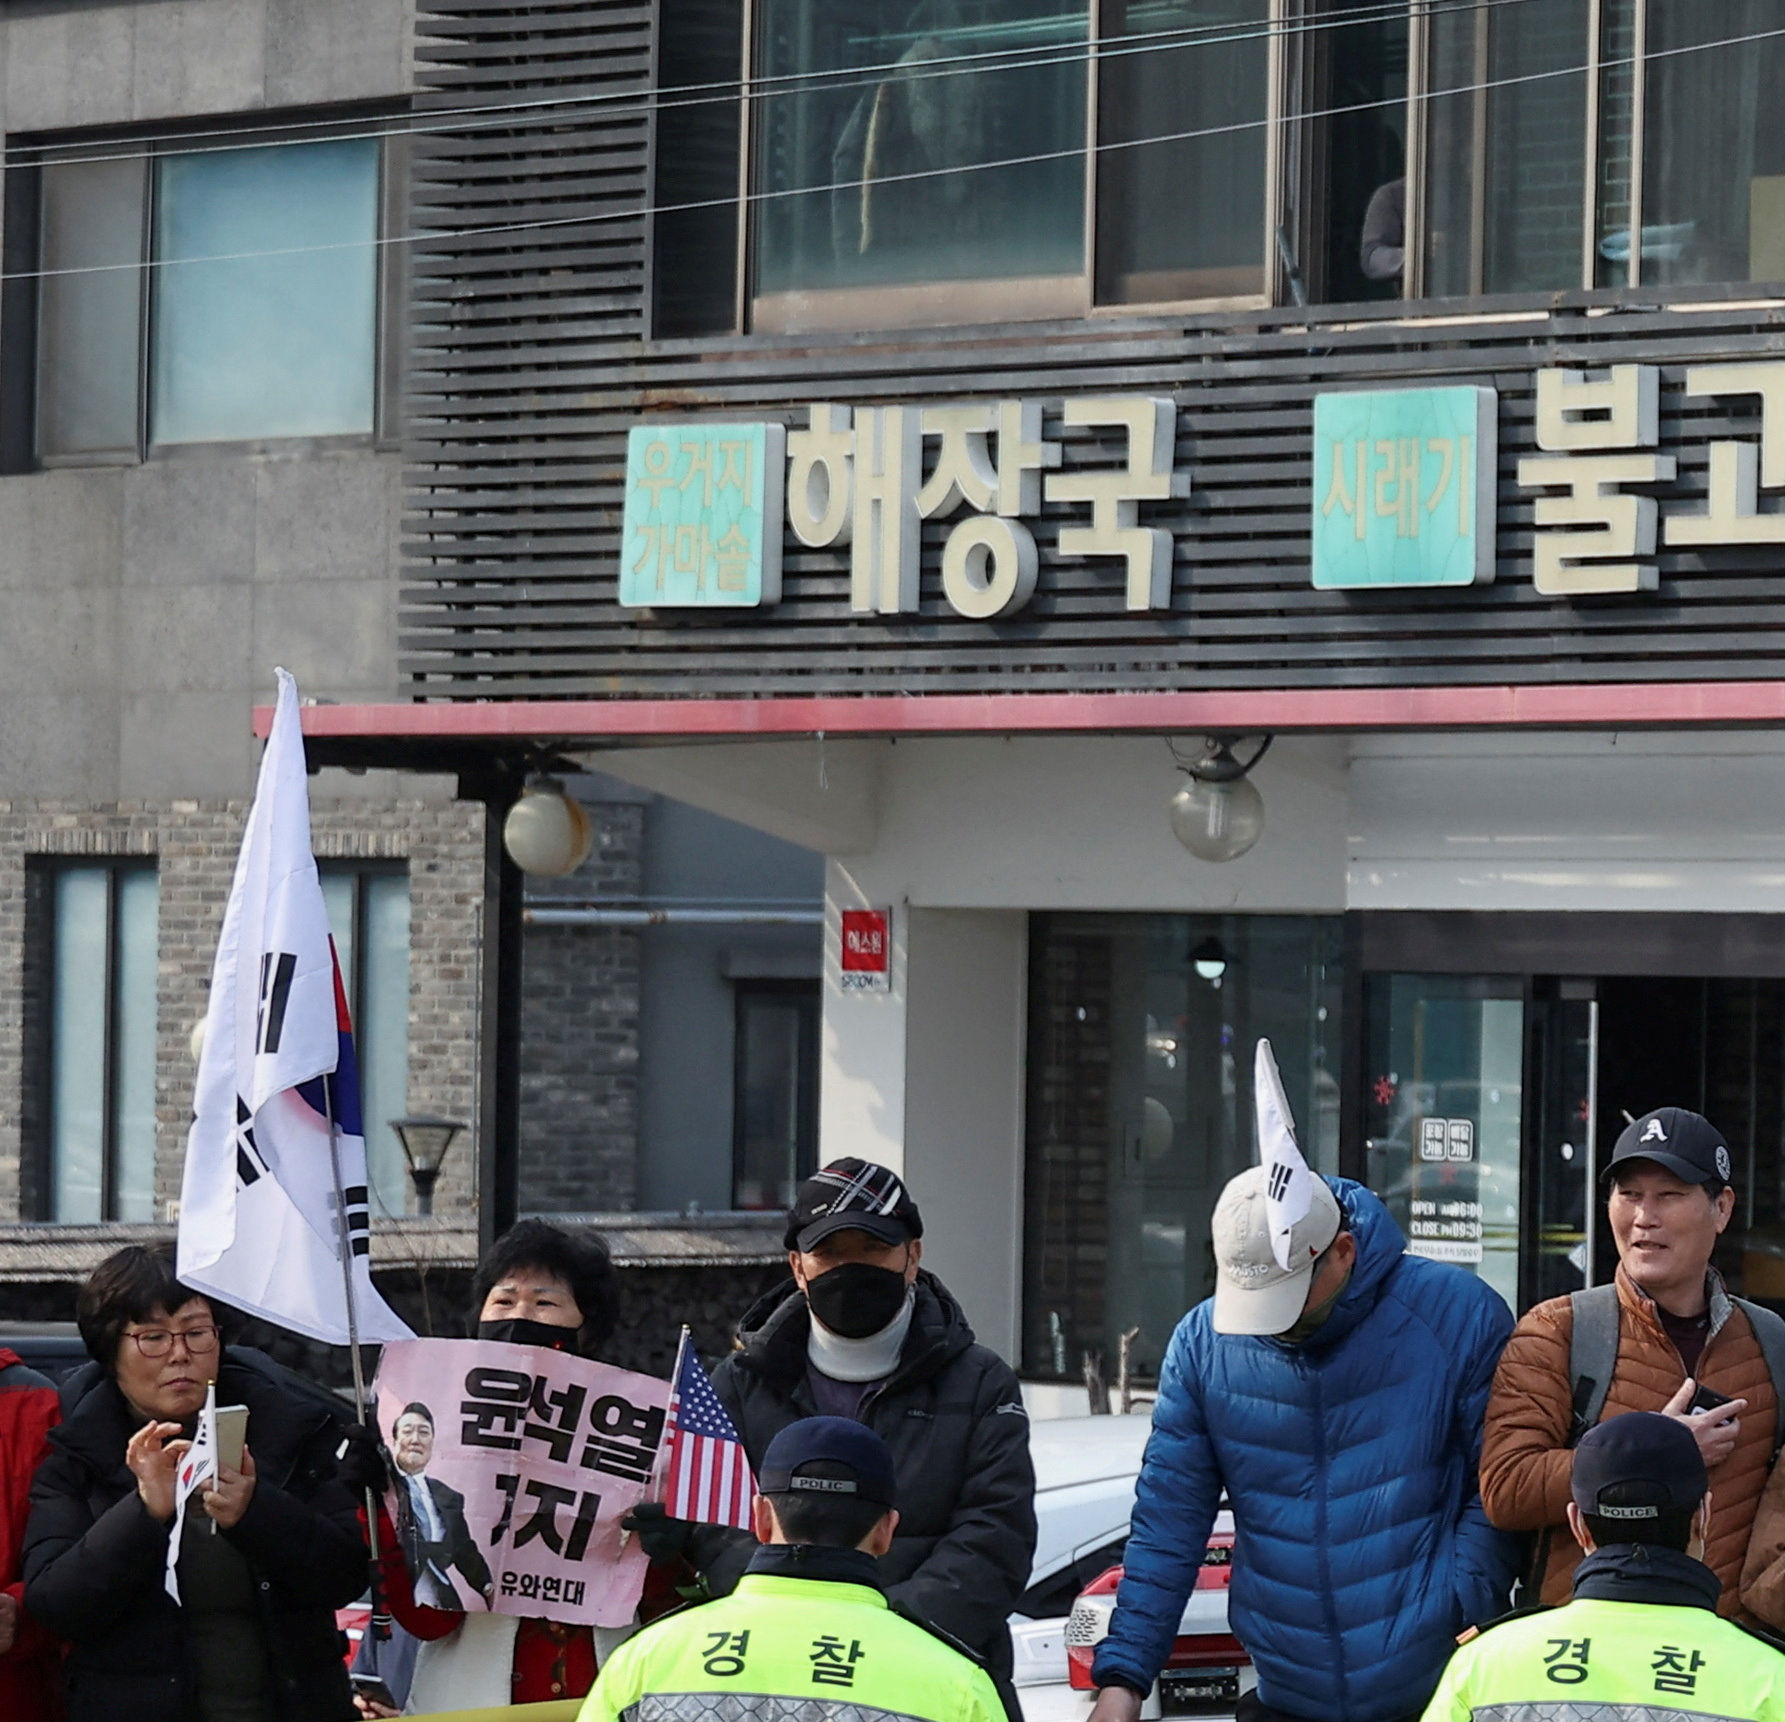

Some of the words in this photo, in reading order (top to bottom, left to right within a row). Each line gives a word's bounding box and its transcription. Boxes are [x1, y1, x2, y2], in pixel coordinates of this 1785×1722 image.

[637, 440, 753, 509] 우거지
[786, 398, 1190, 619] 해장국
[1323, 437, 1476, 543] 시래기
[461, 1367, 666, 1485] 윤석열
